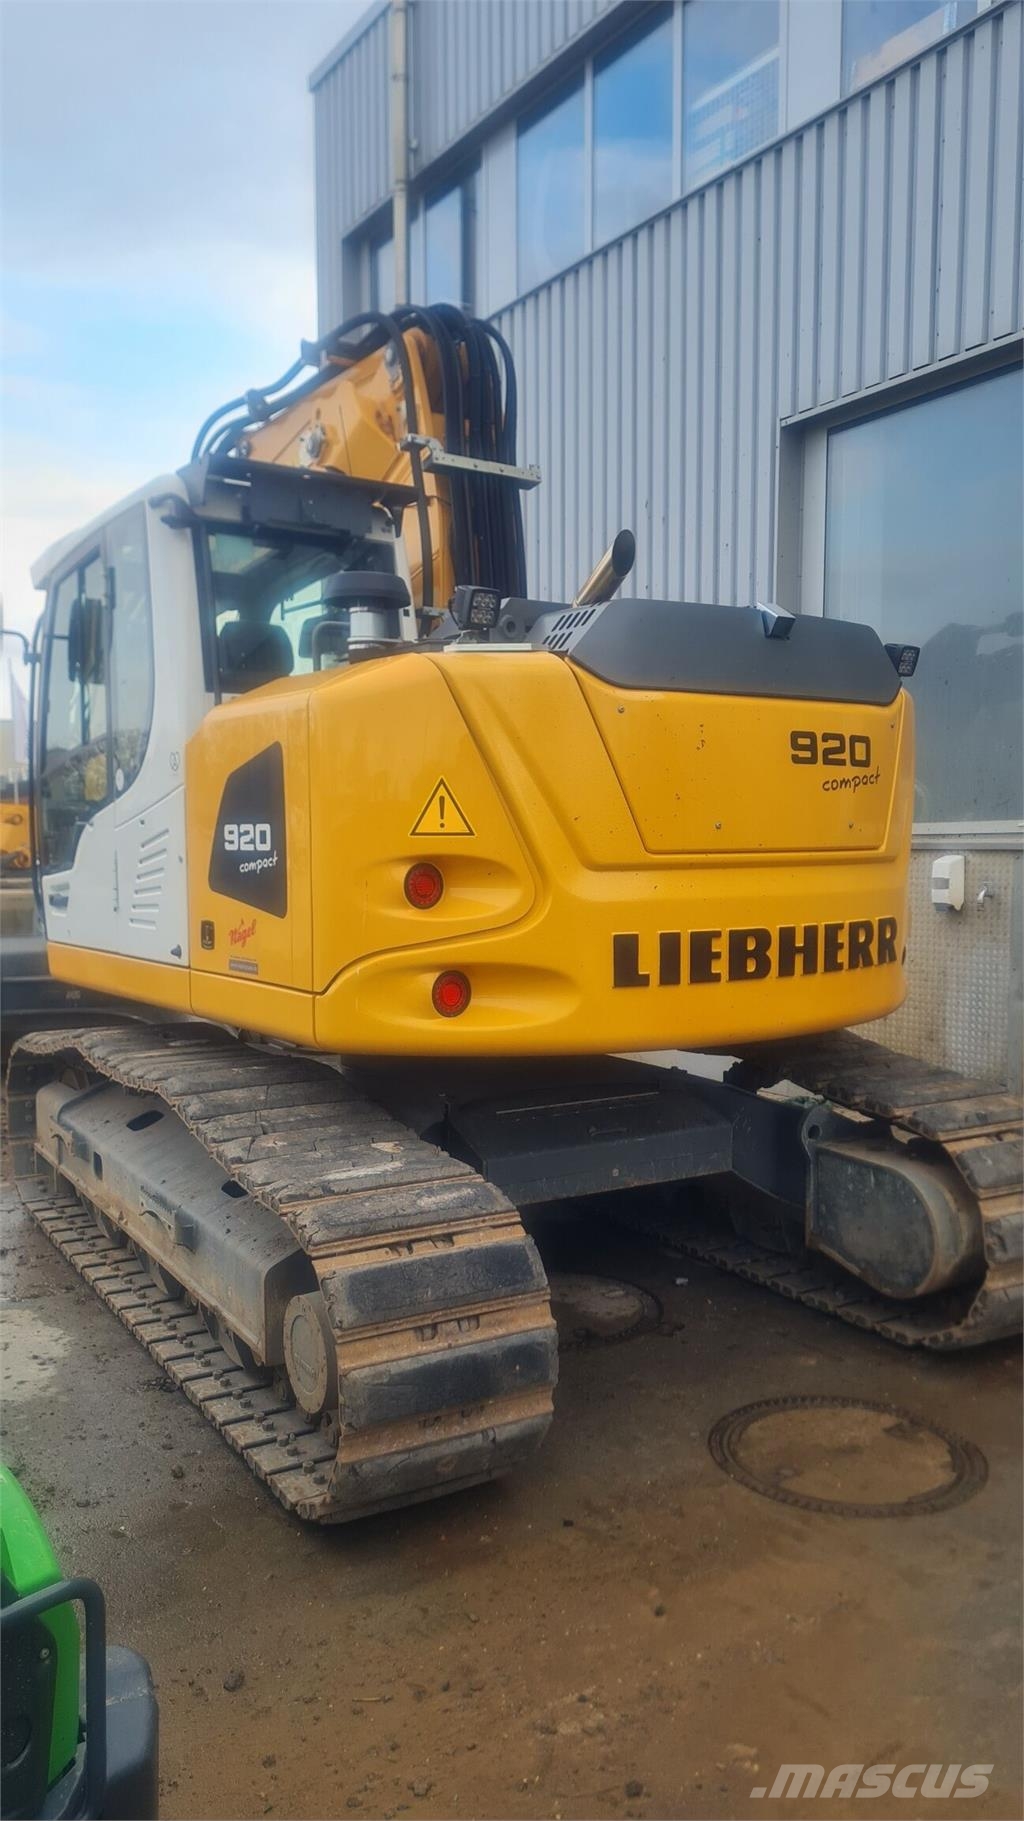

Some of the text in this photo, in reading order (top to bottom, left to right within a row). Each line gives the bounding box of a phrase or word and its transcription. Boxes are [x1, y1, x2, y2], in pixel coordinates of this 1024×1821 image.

[790, 730, 871, 768] 920
[822, 765, 880, 793] compact
[223, 823, 271, 851] 920
[239, 849, 278, 874] compact
[612, 916, 898, 988] LIEBHERR
